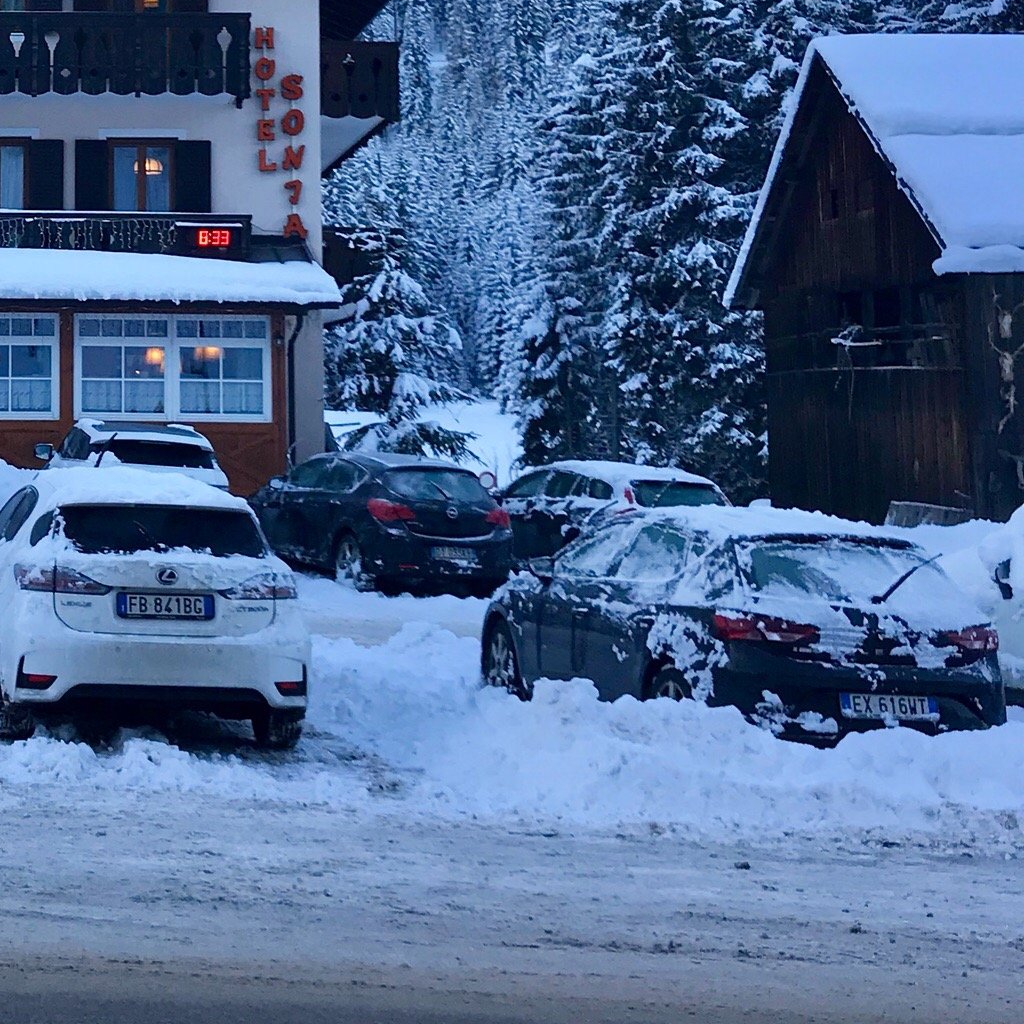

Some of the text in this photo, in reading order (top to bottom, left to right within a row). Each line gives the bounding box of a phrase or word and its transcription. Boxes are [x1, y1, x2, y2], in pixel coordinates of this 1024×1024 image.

[254, 27, 276, 172] HOTEL
[128, 596, 203, 614] FB 841BG
[852, 695, 872, 713] EX
